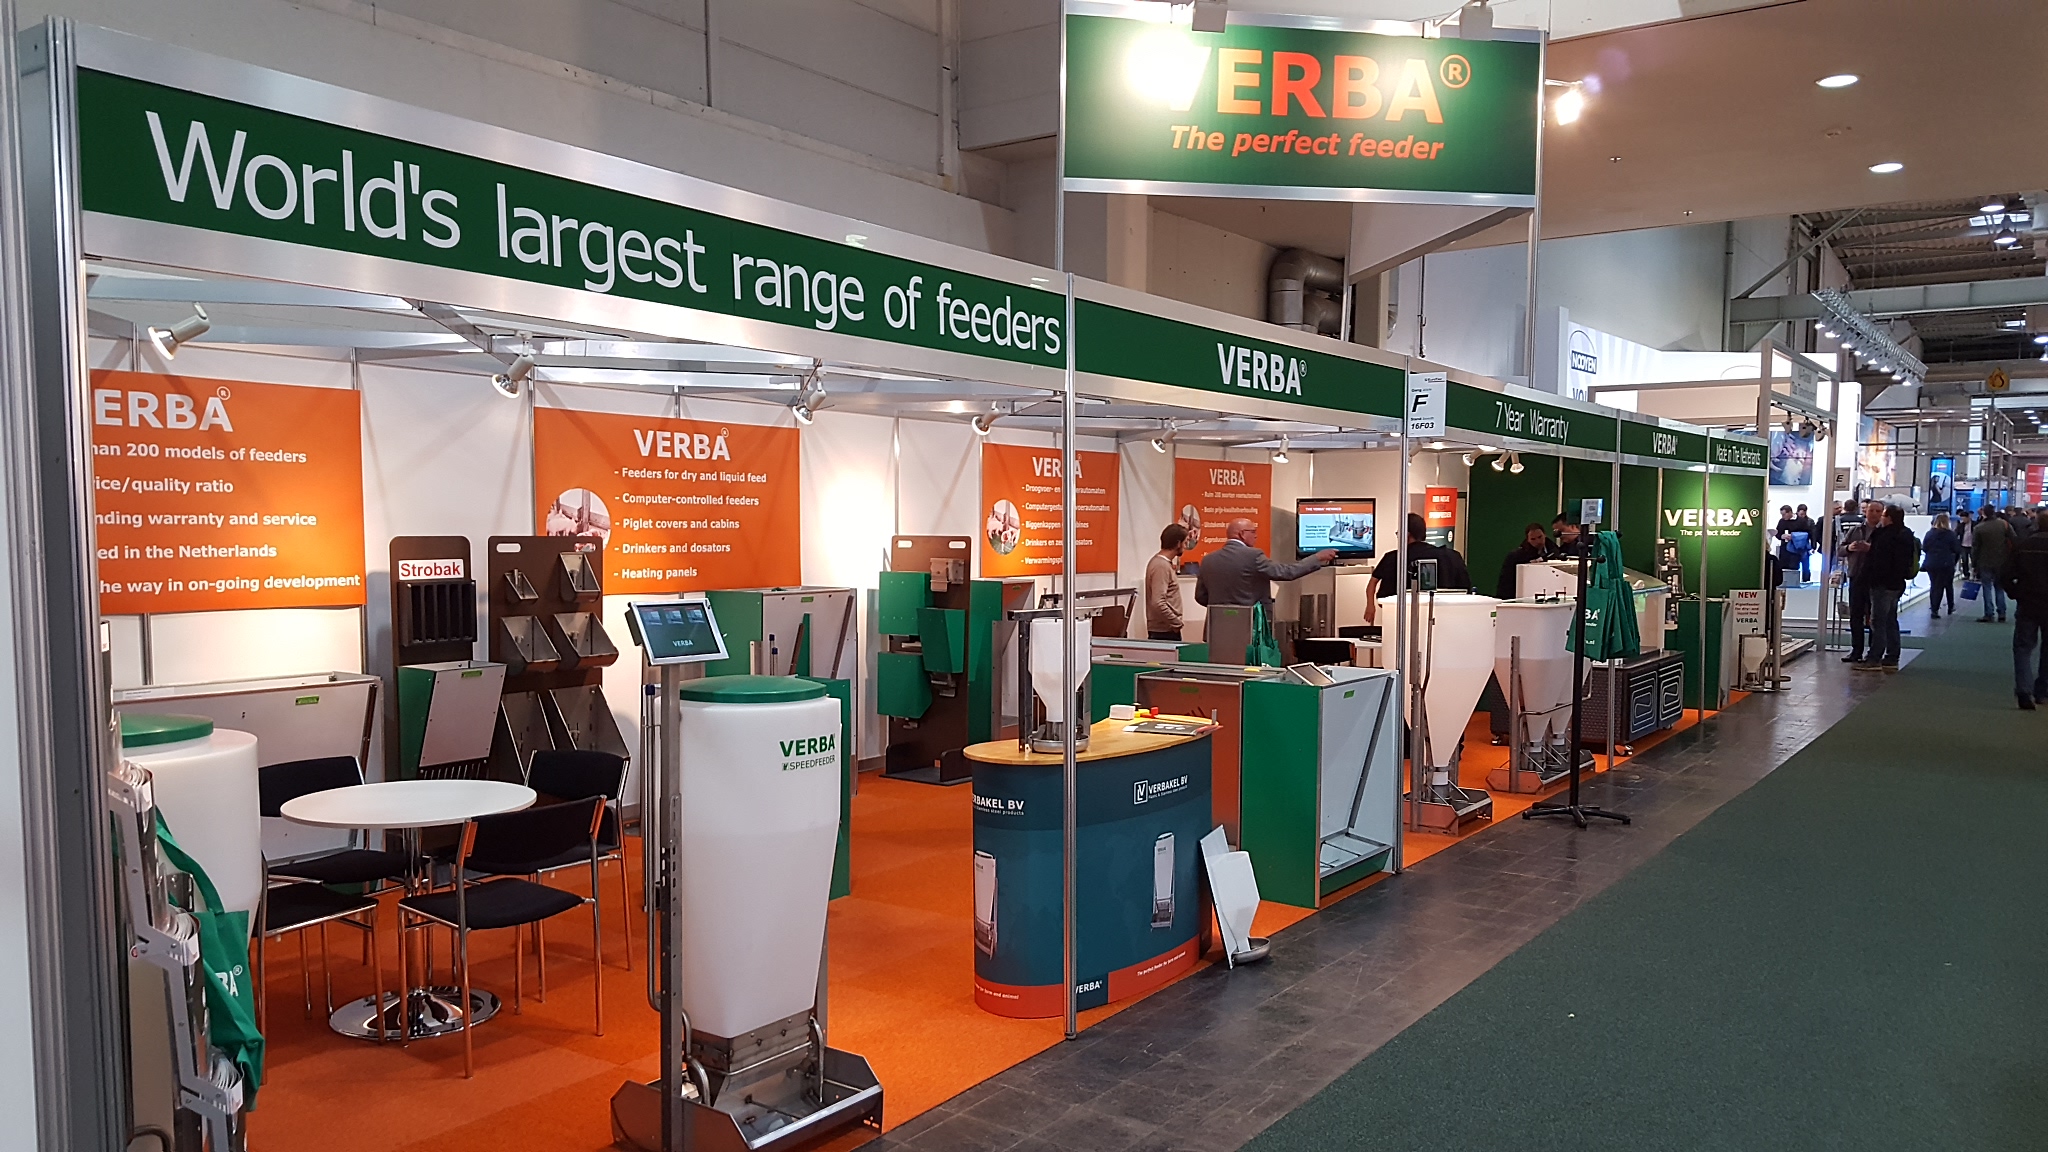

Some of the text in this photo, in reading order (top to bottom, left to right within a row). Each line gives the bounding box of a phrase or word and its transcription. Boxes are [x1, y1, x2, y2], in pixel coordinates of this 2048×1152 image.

[1170, 125, 1444, 160] The perfect feeder
[145, 110, 1061, 355] World's largest range of feeders
[94, 386, 234, 433] ERBA®
[1411, 394, 1429, 413] F
[1411, 422, 1435, 430] 16F03
[1495, 400, 1569, 446] 7 Year Warranty
[126, 443, 160, 457] 200
[165, 446, 225, 460] models
[229, 448, 246, 460] of
[249, 448, 307, 463] feeders
[1715, 443, 1727, 462] Made
[1740, 447, 1761, 466] Netherlands
[622, 468, 767, 483] Feeders for dry and liquid feed
[1032, 455, 1083, 479] VERA
[93, 476, 234, 494] ice/quality ratio
[1835, 474, 1844, 483] E
[622, 493, 759, 506] Computer-controlled feeders
[148, 513, 225, 528] warranty
[229, 512, 259, 525] and
[263, 513, 317, 526] service
[623, 518, 740, 531] Piglet covers and cabins
[124, 545, 140, 559] in
[145, 545, 174, 559] the
[179, 543, 278, 558] Netherlands
[622, 543, 731, 554] Drinkers and dosators
[400, 562, 461, 577] Strobak
[621, 567, 698, 580] Heating panels
[127, 581, 163, 595] way
[168, 578, 184, 591] in
[188, 576, 260, 592] on-going
[264, 574, 361, 590] development
[1738, 591, 1758, 599] NEW
[672, 639, 694, 647] VERBA
[789, 754, 836, 771] SPEEDFEEDER
[1148, 774, 1188, 795] VERBAKEL BV
[972, 793, 1025, 810] RBAKEL BV
